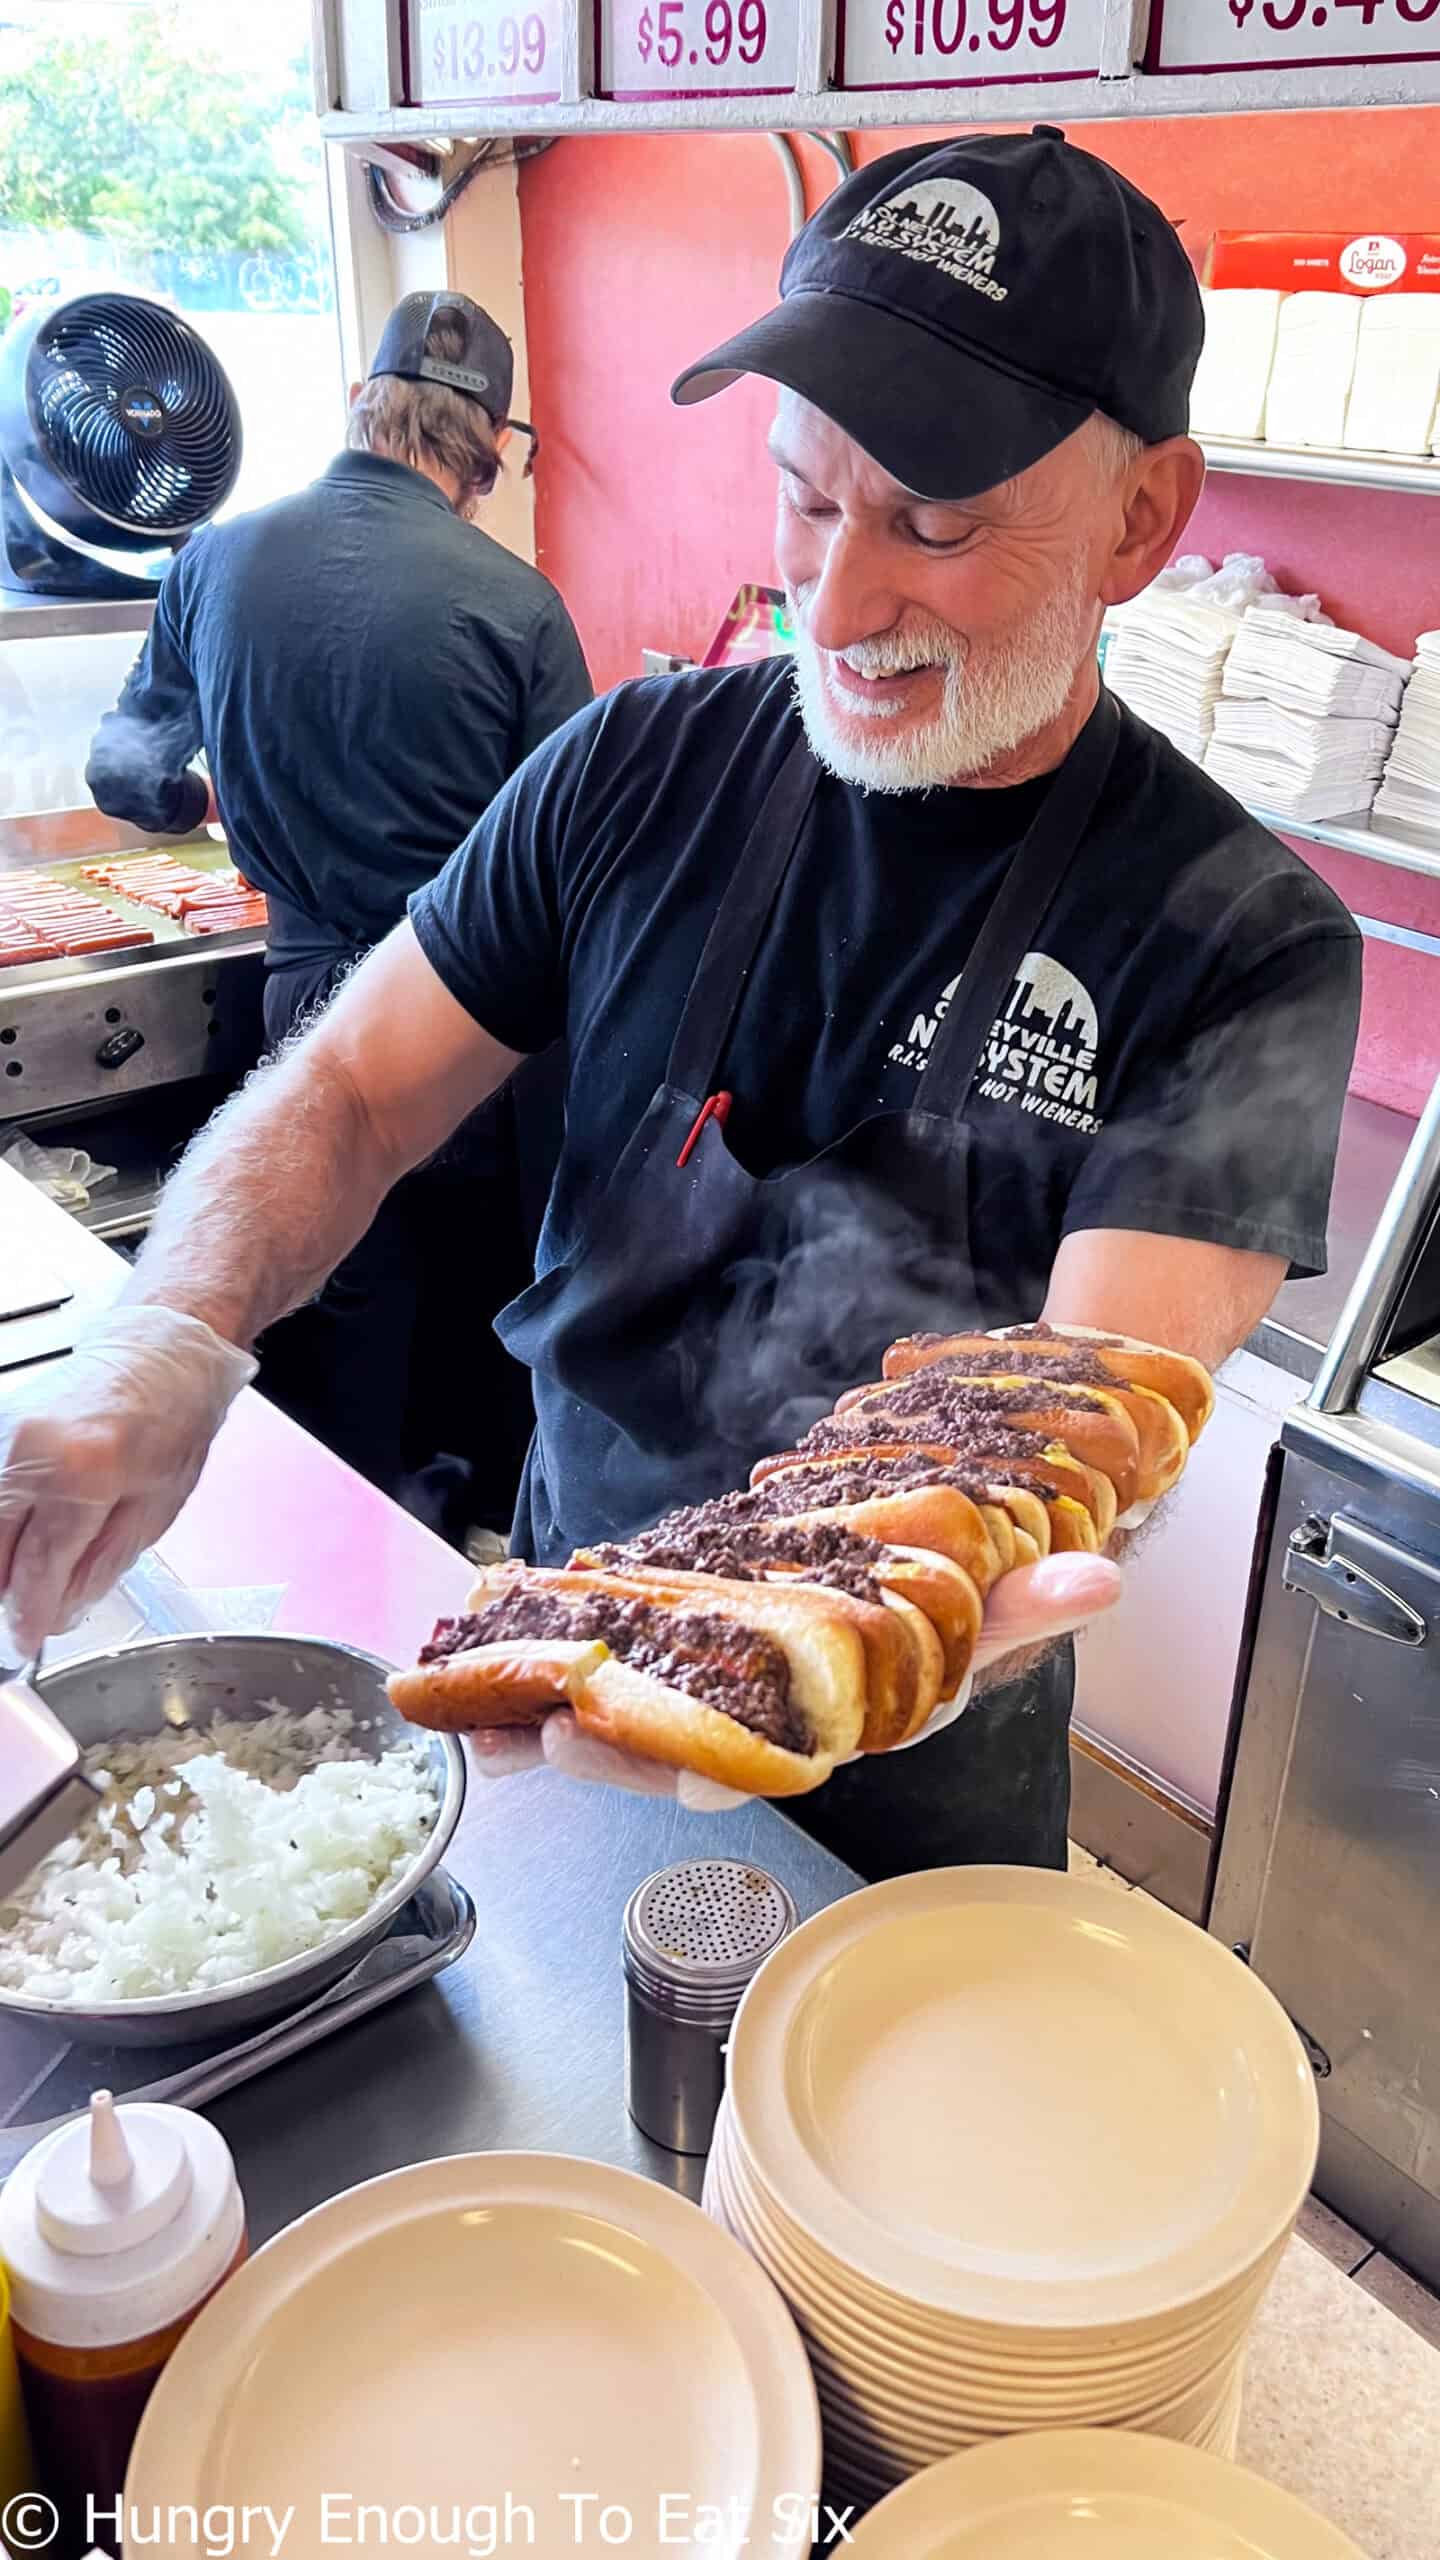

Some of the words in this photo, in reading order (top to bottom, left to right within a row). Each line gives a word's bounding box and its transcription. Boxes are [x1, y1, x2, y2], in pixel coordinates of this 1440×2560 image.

[433, 13, 546, 80] $13.99
[638, 0, 766, 67] $5.99
[885, 0, 1067, 55] $10.99
[894, 230, 997, 275] SYSTEM
[935, 258, 1008, 301] WIENERS
[1348, 250, 1396, 274] Logan
[978, 1078, 1019, 1103] HOT
[1020, 1093, 1103, 1135] WIENERS
